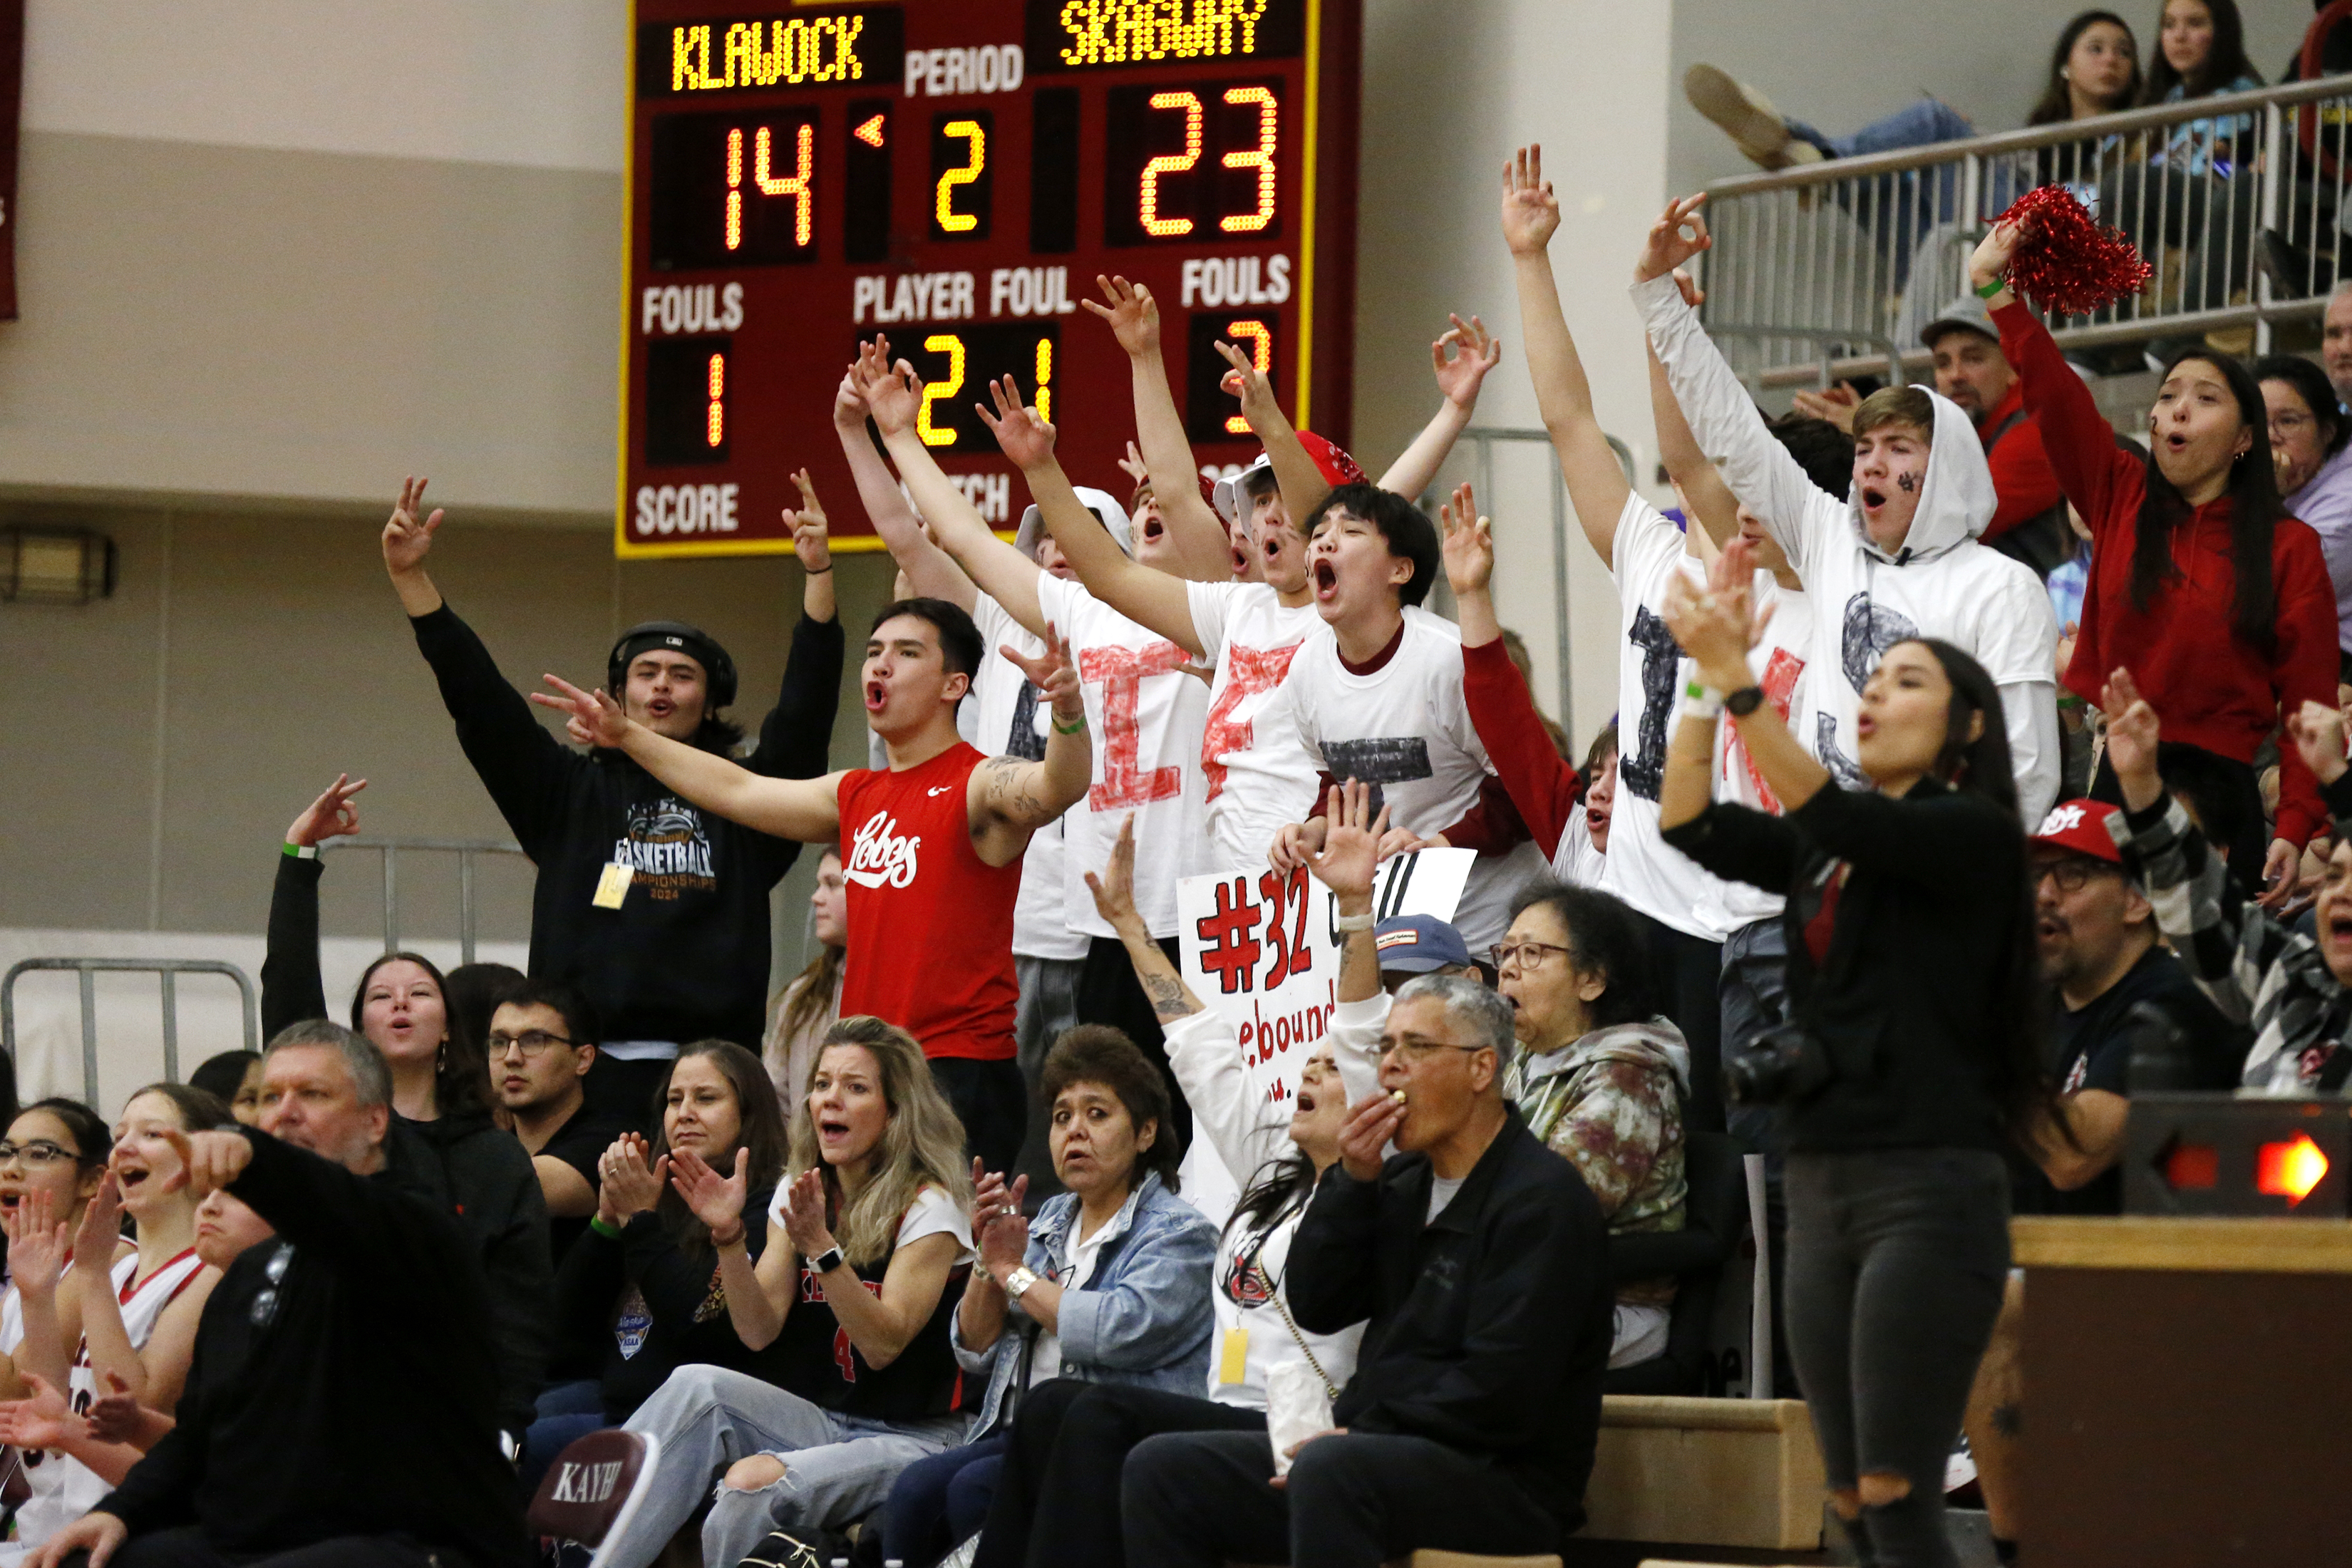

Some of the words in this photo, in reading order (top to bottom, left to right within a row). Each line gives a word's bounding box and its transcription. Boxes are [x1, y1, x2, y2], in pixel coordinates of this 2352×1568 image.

[673, 16, 862, 91] KLAWOCK
[1061, 0, 1267, 65] SKAGWAY
[904, 44, 1024, 98] PERIOD
[726, 124, 813, 249] 14
[936, 120, 985, 232] 2
[1140, 86, 1276, 237] 23
[642, 284, 744, 334] FOULS
[855, 272, 974, 324] PLAYER
[991, 267, 1076, 317] FOUL
[1181, 255, 1290, 307] FOULS
[708, 353, 724, 446] 1
[636, 484, 738, 535] SCORE
[1078, 641, 1193, 813] I
[614, 840, 716, 877] BASKETBALL
[630, 872, 717, 890] AMPIONSHIPS
[842, 810, 919, 889] Lobos
[650, 888, 679, 900] 2024
[1197, 862, 1312, 994] #32
[1239, 979, 1336, 1069] ebound
[551, 1461, 623, 1503] KAYHI
